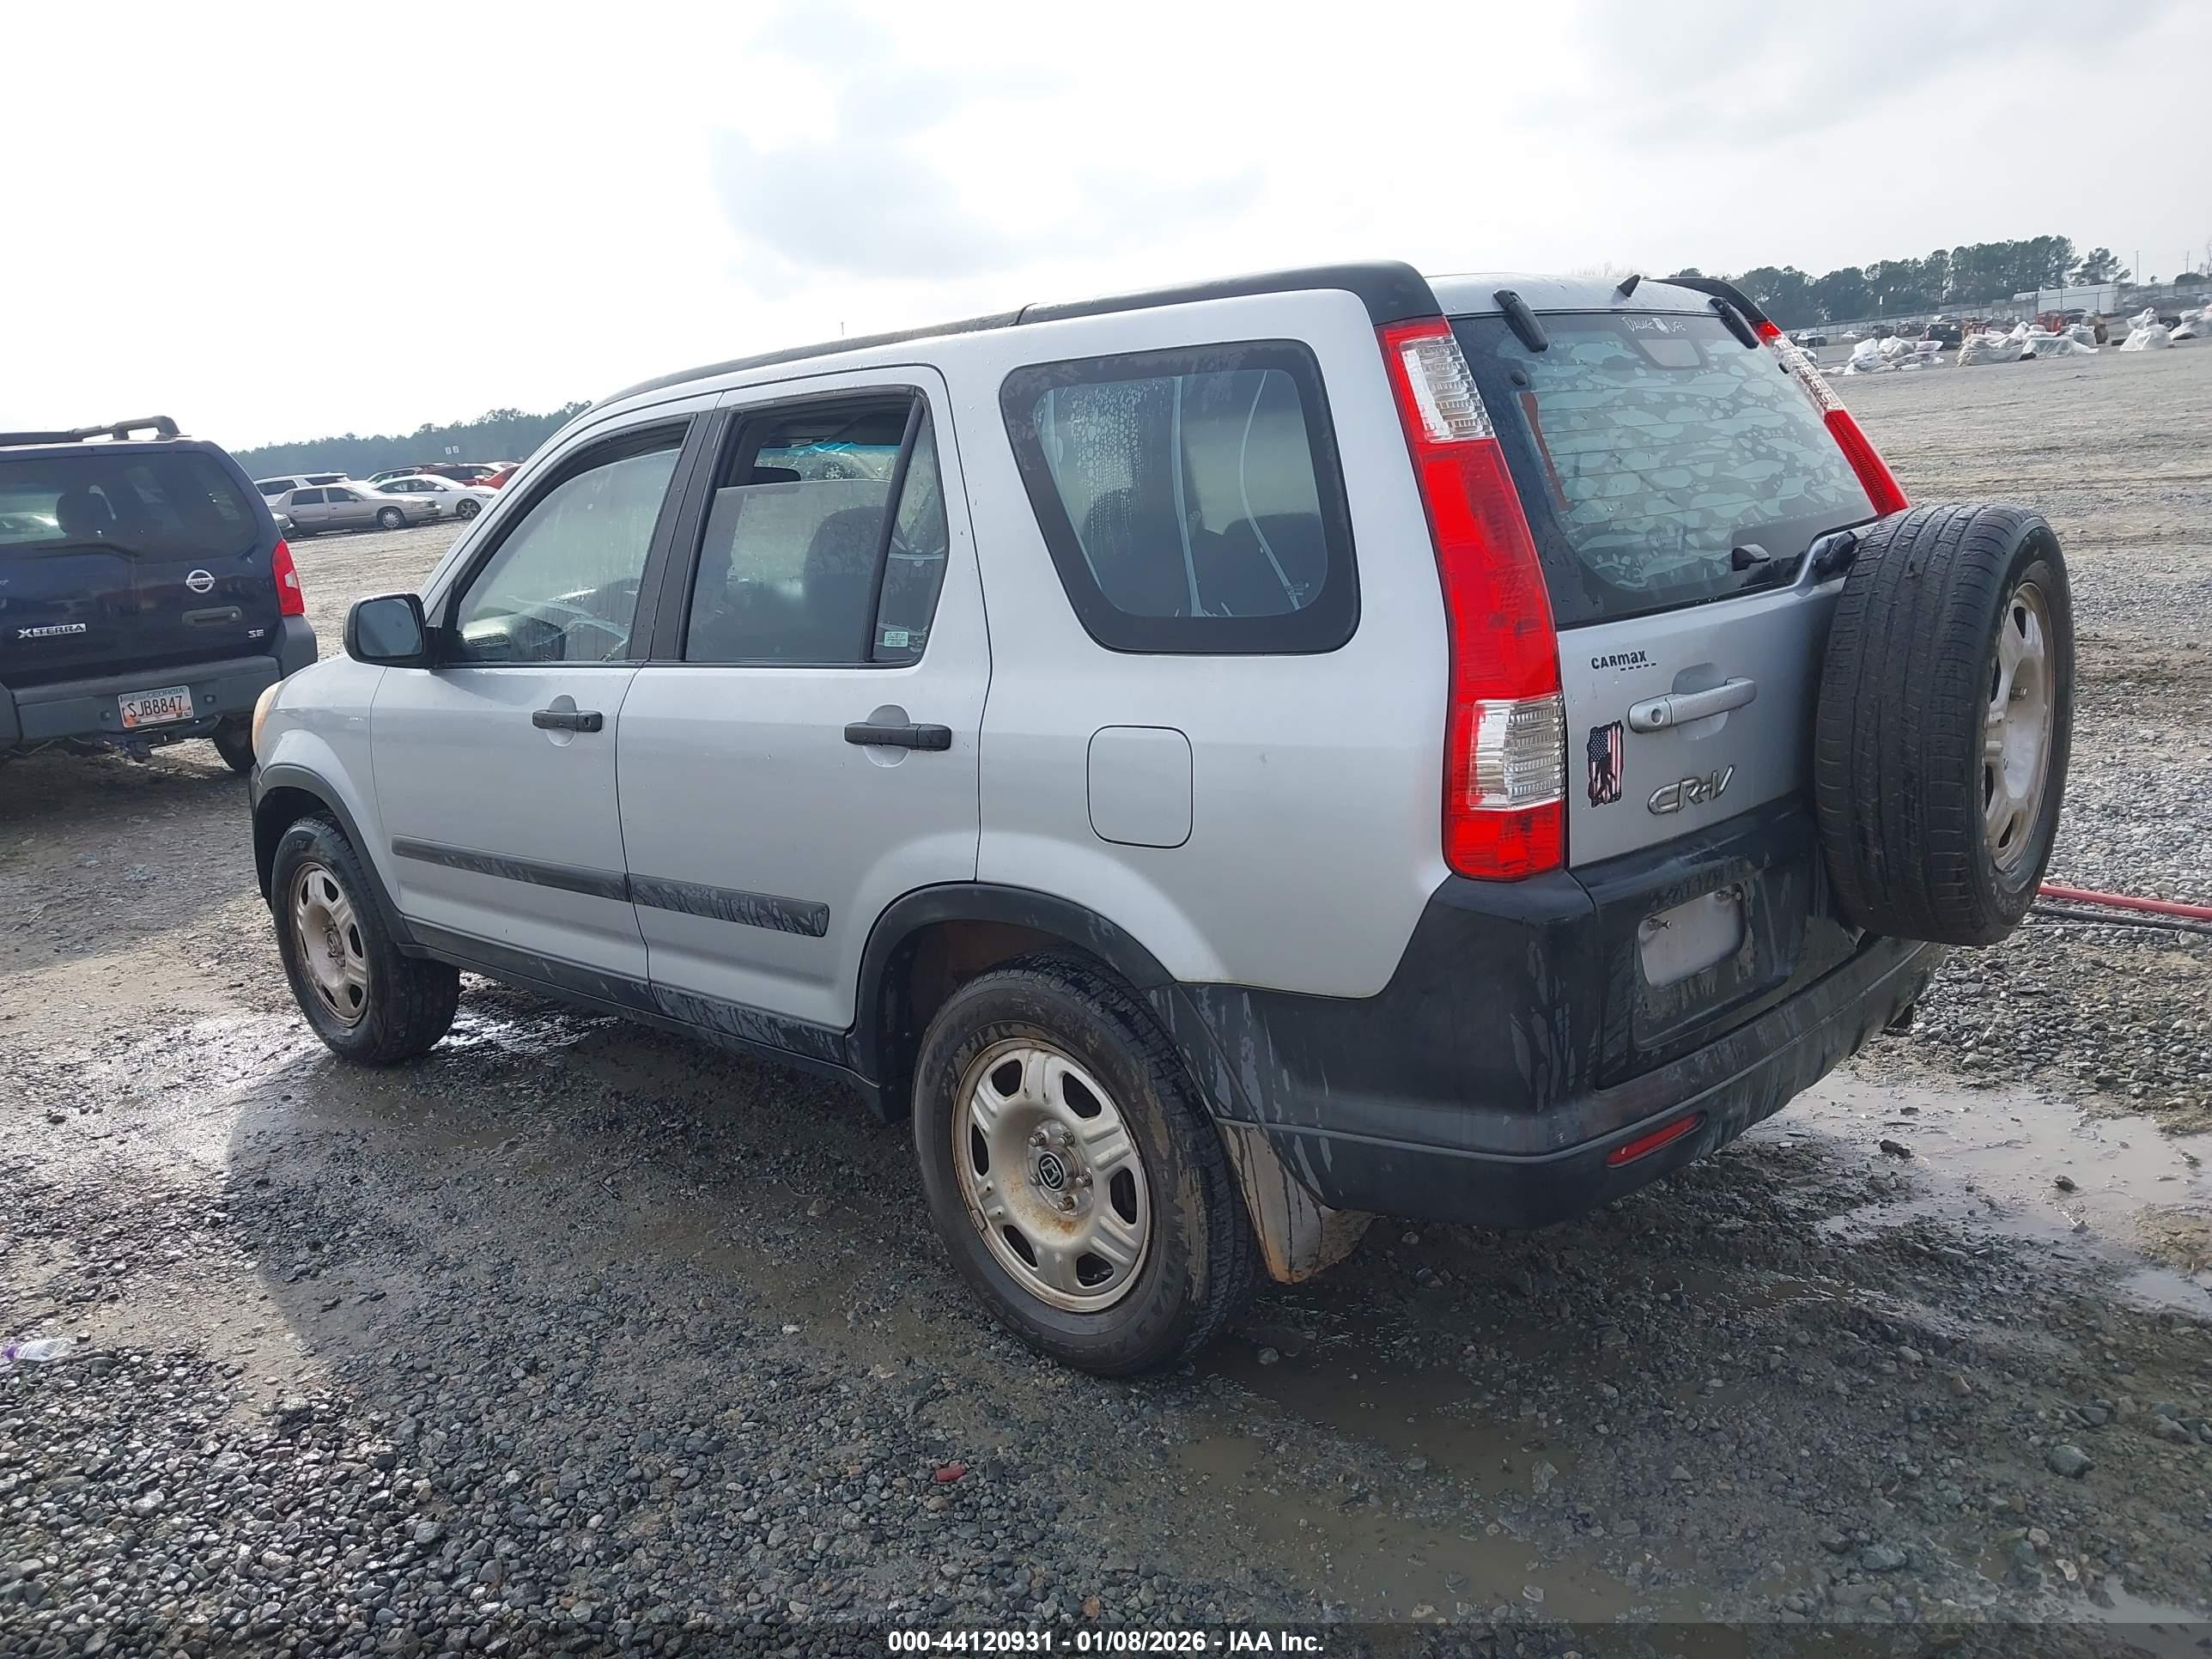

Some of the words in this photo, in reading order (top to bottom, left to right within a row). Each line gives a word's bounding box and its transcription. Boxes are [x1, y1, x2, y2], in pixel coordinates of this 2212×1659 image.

[248, 629, 264, 639] SE
[146, 688, 185, 699] GEORGIA
[126, 695, 183, 718] SJB8847
